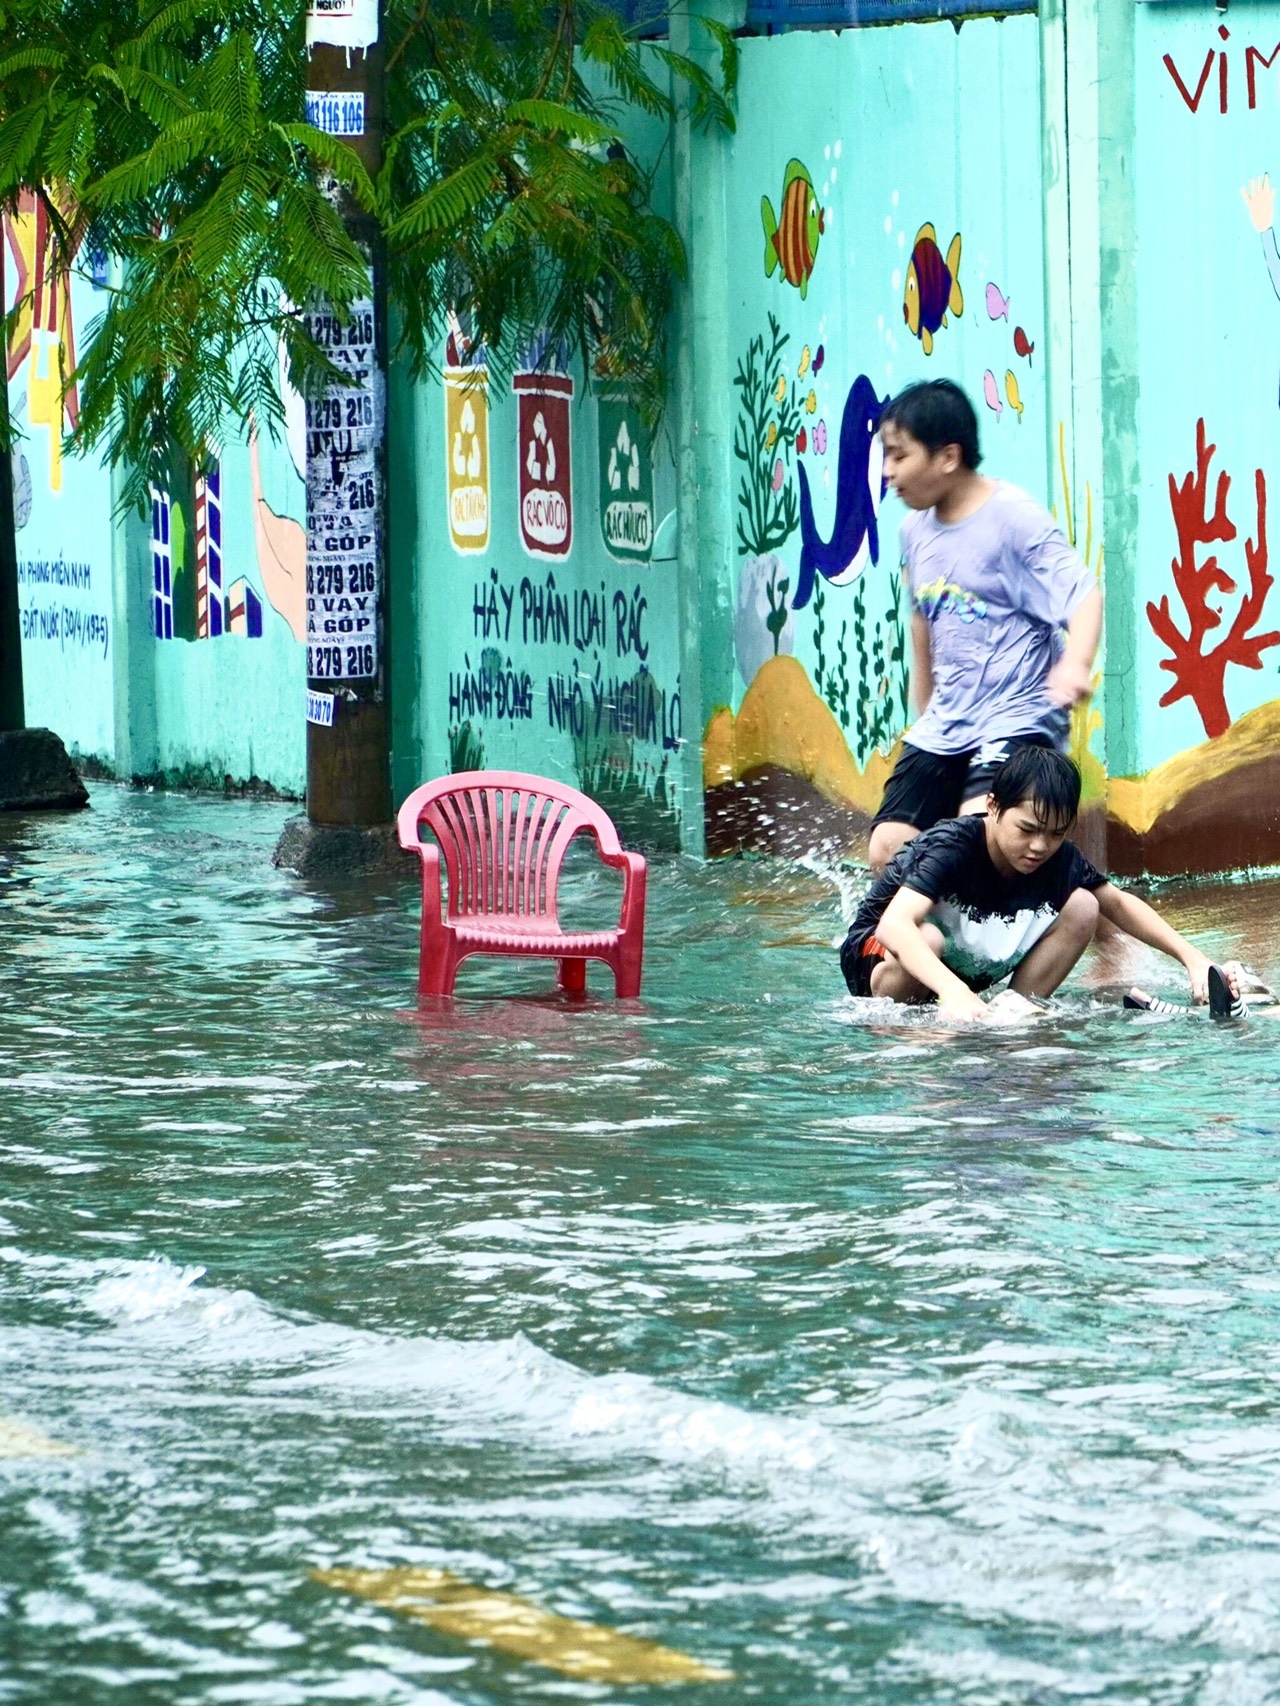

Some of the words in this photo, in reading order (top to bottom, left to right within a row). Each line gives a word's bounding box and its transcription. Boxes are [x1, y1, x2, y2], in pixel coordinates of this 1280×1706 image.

[315, 315, 342, 347] 279
[347, 313, 373, 346] 216
[315, 398, 342, 429] 279
[348, 478, 375, 511] 216
[325, 533, 371, 551] GÓP
[71, 562, 90, 590] NAM
[316, 563, 344, 595] 279
[348, 561, 375, 593] 216
[308, 598, 316, 612] O
[322, 596, 369, 612] VAY
[473, 567, 515, 642] HÃY
[520, 571, 570, 645] PHÂN
[613, 583, 648, 661] RÁC
[308, 614, 317, 633] Ả
[324, 616, 370, 634] GÓP
[316, 646, 342, 677] 279
[346, 644, 374, 676] 216
[449, 651, 492, 725] HÀNH
[495, 656, 533, 731] ĐỘNG
